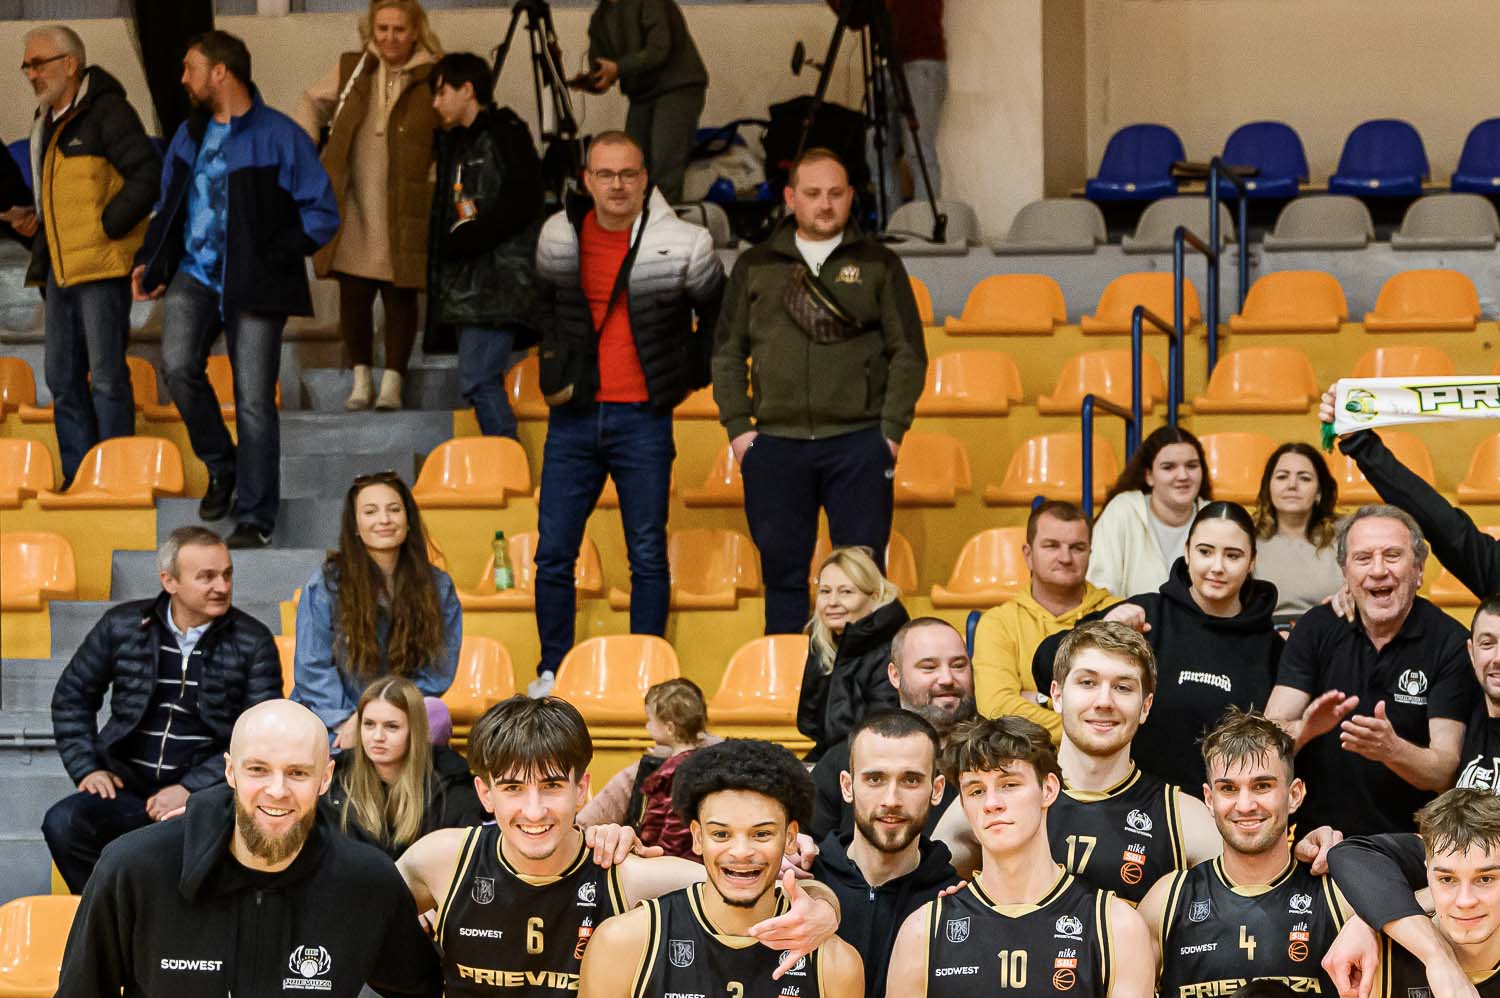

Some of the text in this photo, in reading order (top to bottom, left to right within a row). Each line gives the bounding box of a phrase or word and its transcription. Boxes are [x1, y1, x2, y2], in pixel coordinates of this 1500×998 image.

[1065, 835, 1097, 874] 17
[1127, 843, 1146, 855] niké
[460, 927, 503, 939] SÜDWEST
[526, 917, 544, 955] 6
[1180, 943, 1218, 955] SÜDWEST
[1239, 925, 1256, 960] 4
[161, 958, 223, 971] SÜDWEST
[998, 950, 1028, 989] 10
[456, 963, 580, 990] PRIEVIDZ
[935, 966, 980, 977] SÜDWEST
[781, 986, 800, 997] niké
